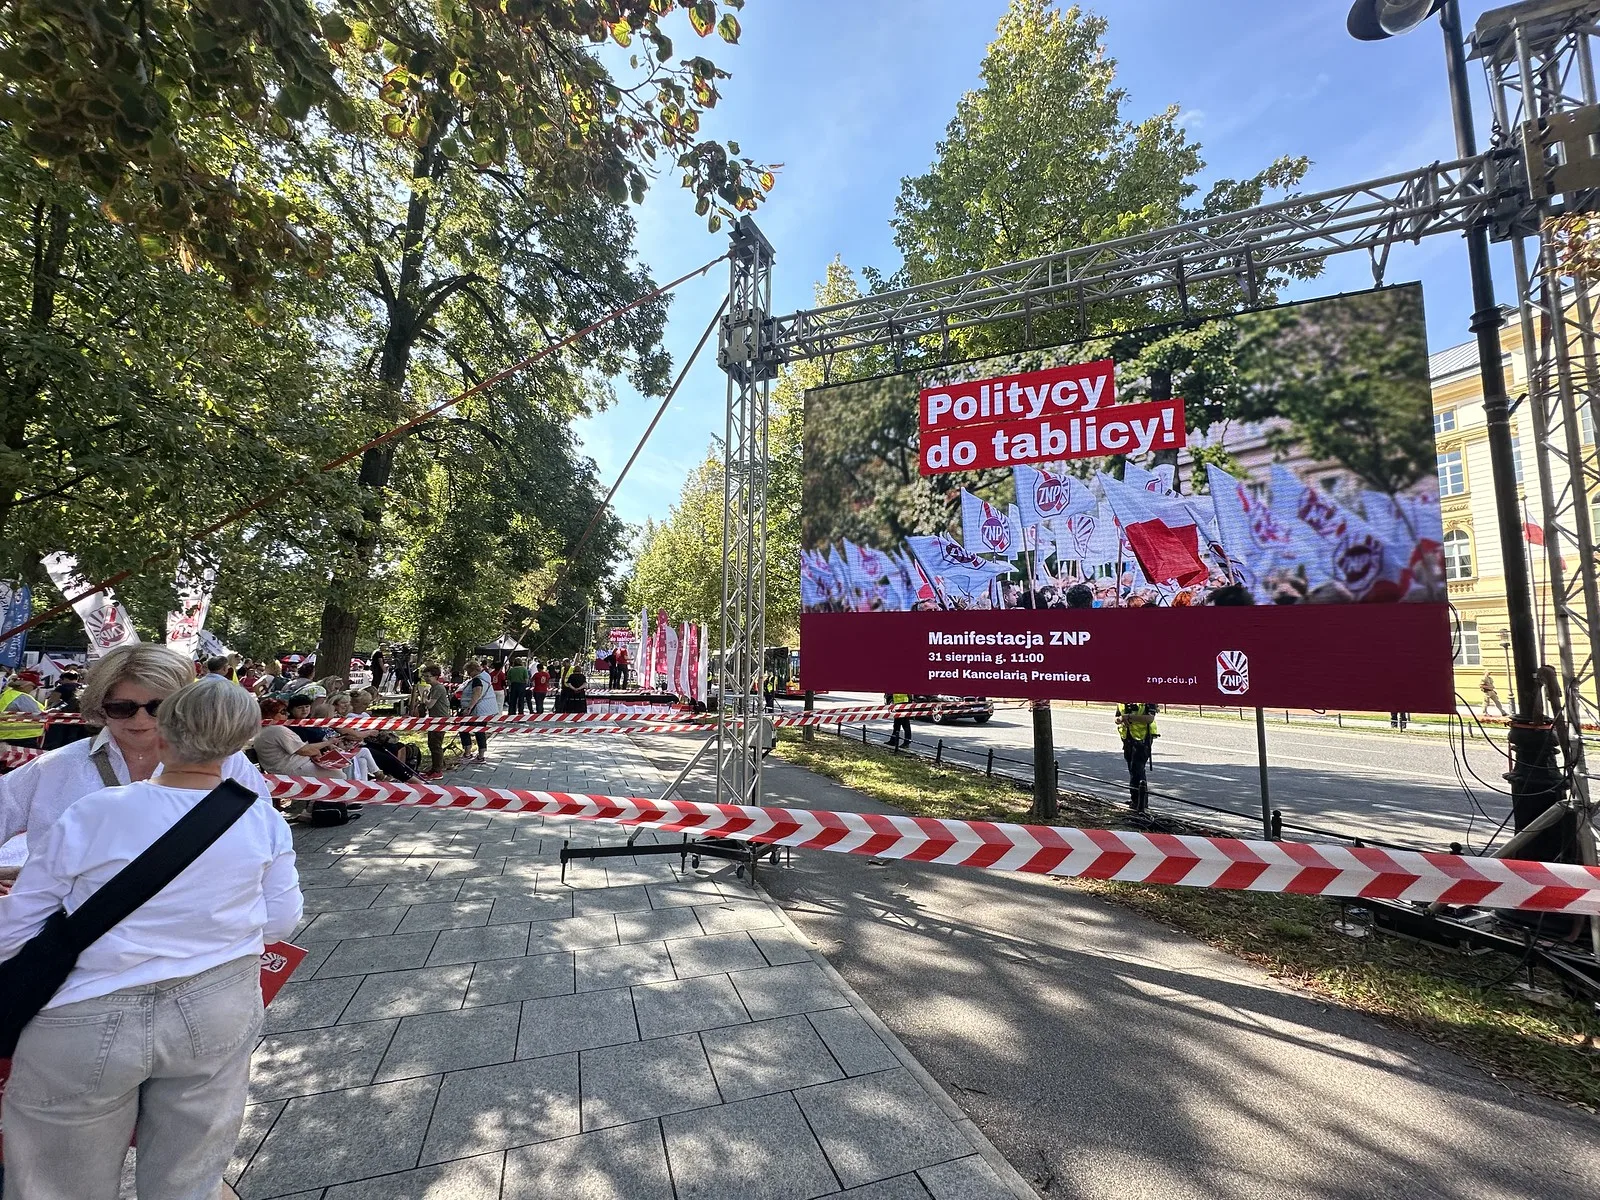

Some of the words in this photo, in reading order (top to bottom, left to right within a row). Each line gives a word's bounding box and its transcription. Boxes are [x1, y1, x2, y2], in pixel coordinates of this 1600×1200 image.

[927, 374, 1107, 425] Politycy
[926, 435, 977, 469] do
[991, 407, 1175, 461] tablicy!
[1037, 484, 1060, 505] ZNP
[928, 631, 1044, 648] Manifestacja
[1049, 631, 1091, 646] ZNP
[928, 652, 942, 662] 31
[945, 652, 992, 664] sierpnia
[995, 654, 1007, 665] g.
[1010, 653, 1045, 663] 11:00
[928, 669, 959, 680] przed
[962, 669, 1028, 682] Kancelarią
[1031, 670, 1091, 682] Premiera
[1146, 675, 1198, 686] znp.edu.pl
[1222, 675, 1242, 687] ZNP
